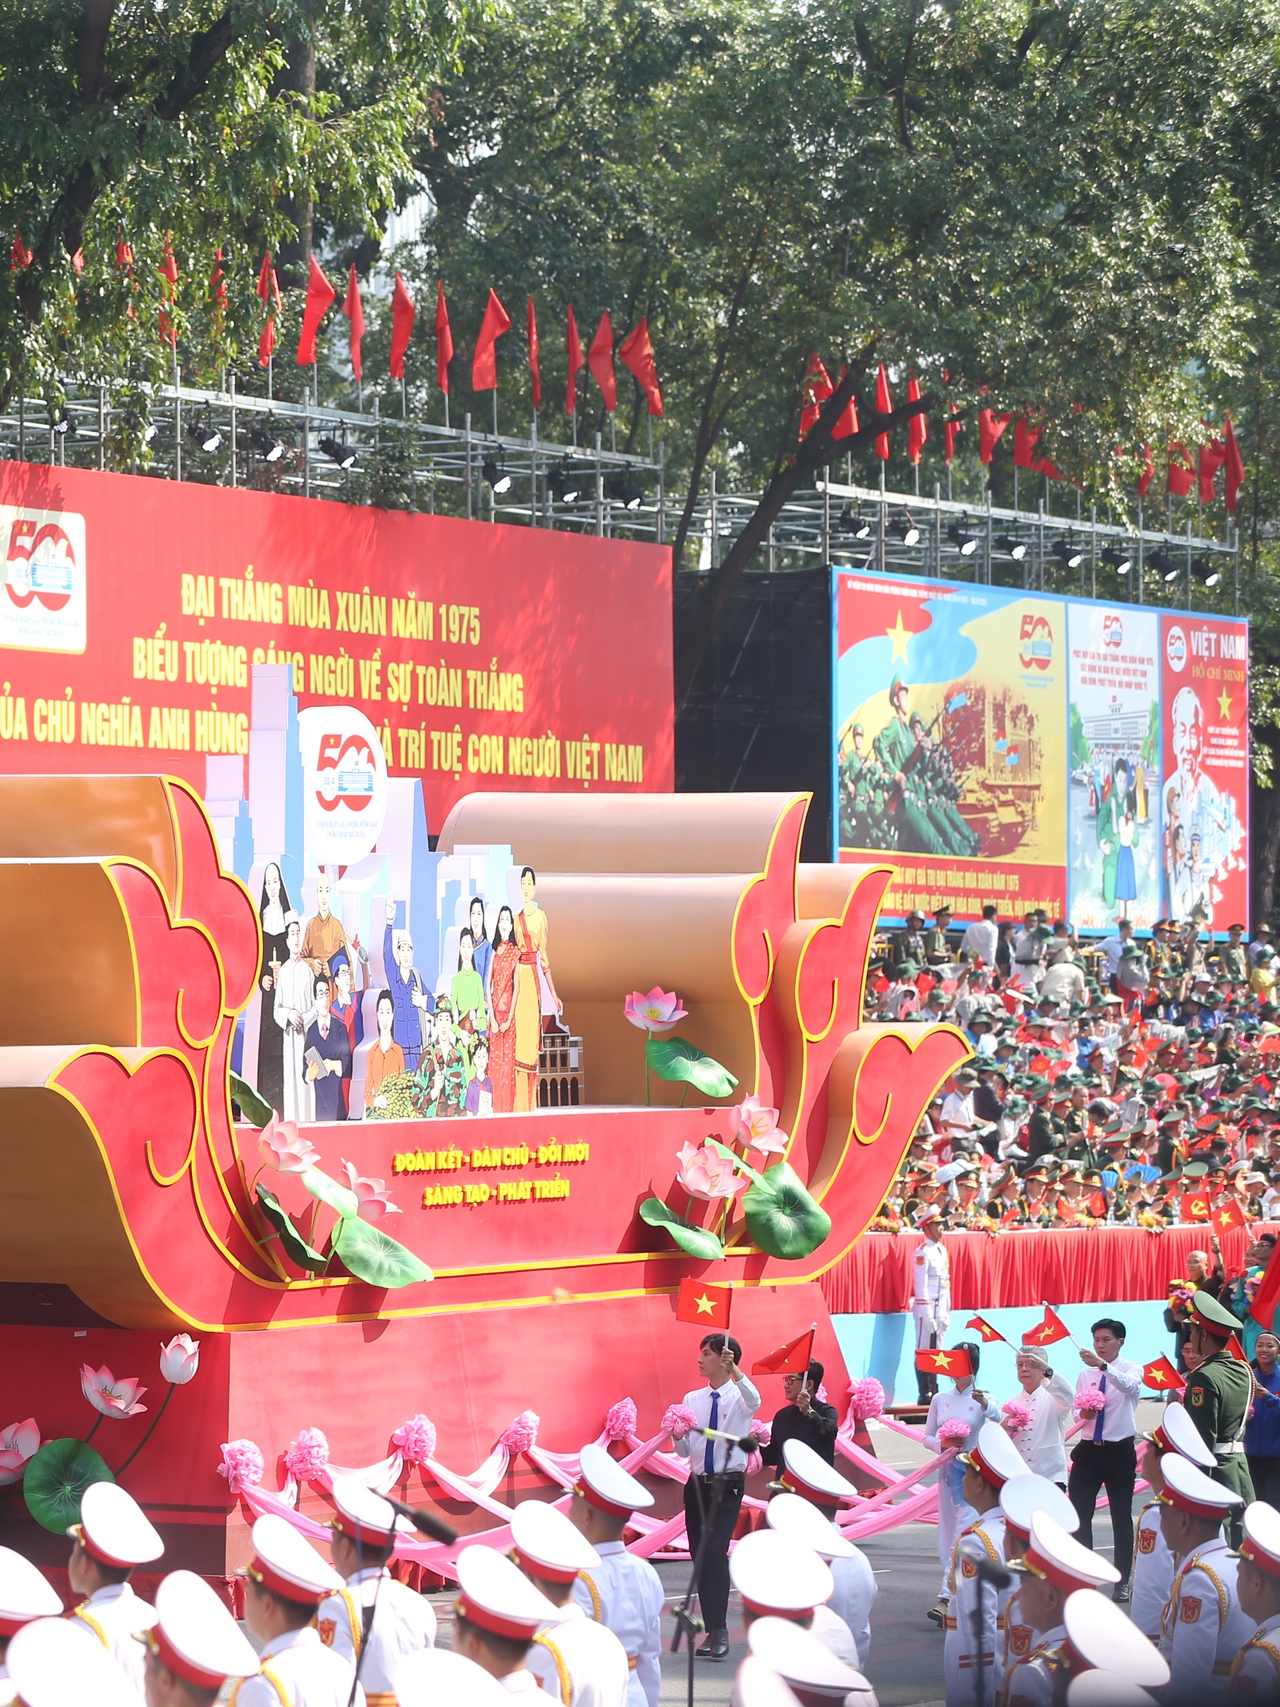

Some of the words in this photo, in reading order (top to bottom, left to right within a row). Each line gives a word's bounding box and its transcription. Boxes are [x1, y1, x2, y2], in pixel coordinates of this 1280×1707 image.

[5, 519, 76, 611] 50
[181, 573, 215, 626] ĐẠI
[219, 565, 283, 624] THẮNG
[288, 579, 331, 630] MÙA
[335, 586, 387, 636] XUÂN
[391, 591, 434, 641] NĂM
[439, 603, 480, 645] 1975
[1190, 625, 1217, 662] VIỆT
[1220, 634, 1246, 660] NAM
[133, 622, 179, 682] BIỂU
[183, 636, 248, 695] TƯỢNG
[309, 647, 355, 699] NGỜI
[359, 648, 382, 701] VỀ
[387, 660, 413, 710] SỰ
[416, 658, 463, 708] TOÀN
[467, 657, 524, 713] THẮNG
[1223, 669, 1244, 682] MINH
[33, 686, 76, 744] CHỦ
[81, 696, 144, 747] NGHĨA
[148, 706, 191, 750] ANH
[195, 702, 249, 755] HÙNG
[398, 722, 426, 769] TRÍ
[430, 724, 463, 780] TUỆ
[467, 733, 504, 775] CON
[509, 730, 561, 778] NGƯỜI
[565, 733, 601, 788] VIỆT
[605, 742, 644, 783] NAM
[315, 734, 376, 812] 50
[394, 1148, 436, 1172] ĐOÀN
[437, 1143, 464, 1170] KẾT
[472, 1145, 502, 1168] DÂN
[503, 1142, 530, 1166] CHỦ
[537, 1137, 562, 1165] ĐỔI
[563, 1138, 590, 1162] MỚI
[423, 1183, 463, 1207] SÁNG
[464, 1184, 490, 1207] TẠO
[498, 1178, 533, 1201] PHÁT
[533, 1172, 570, 1199] TRIỂN
